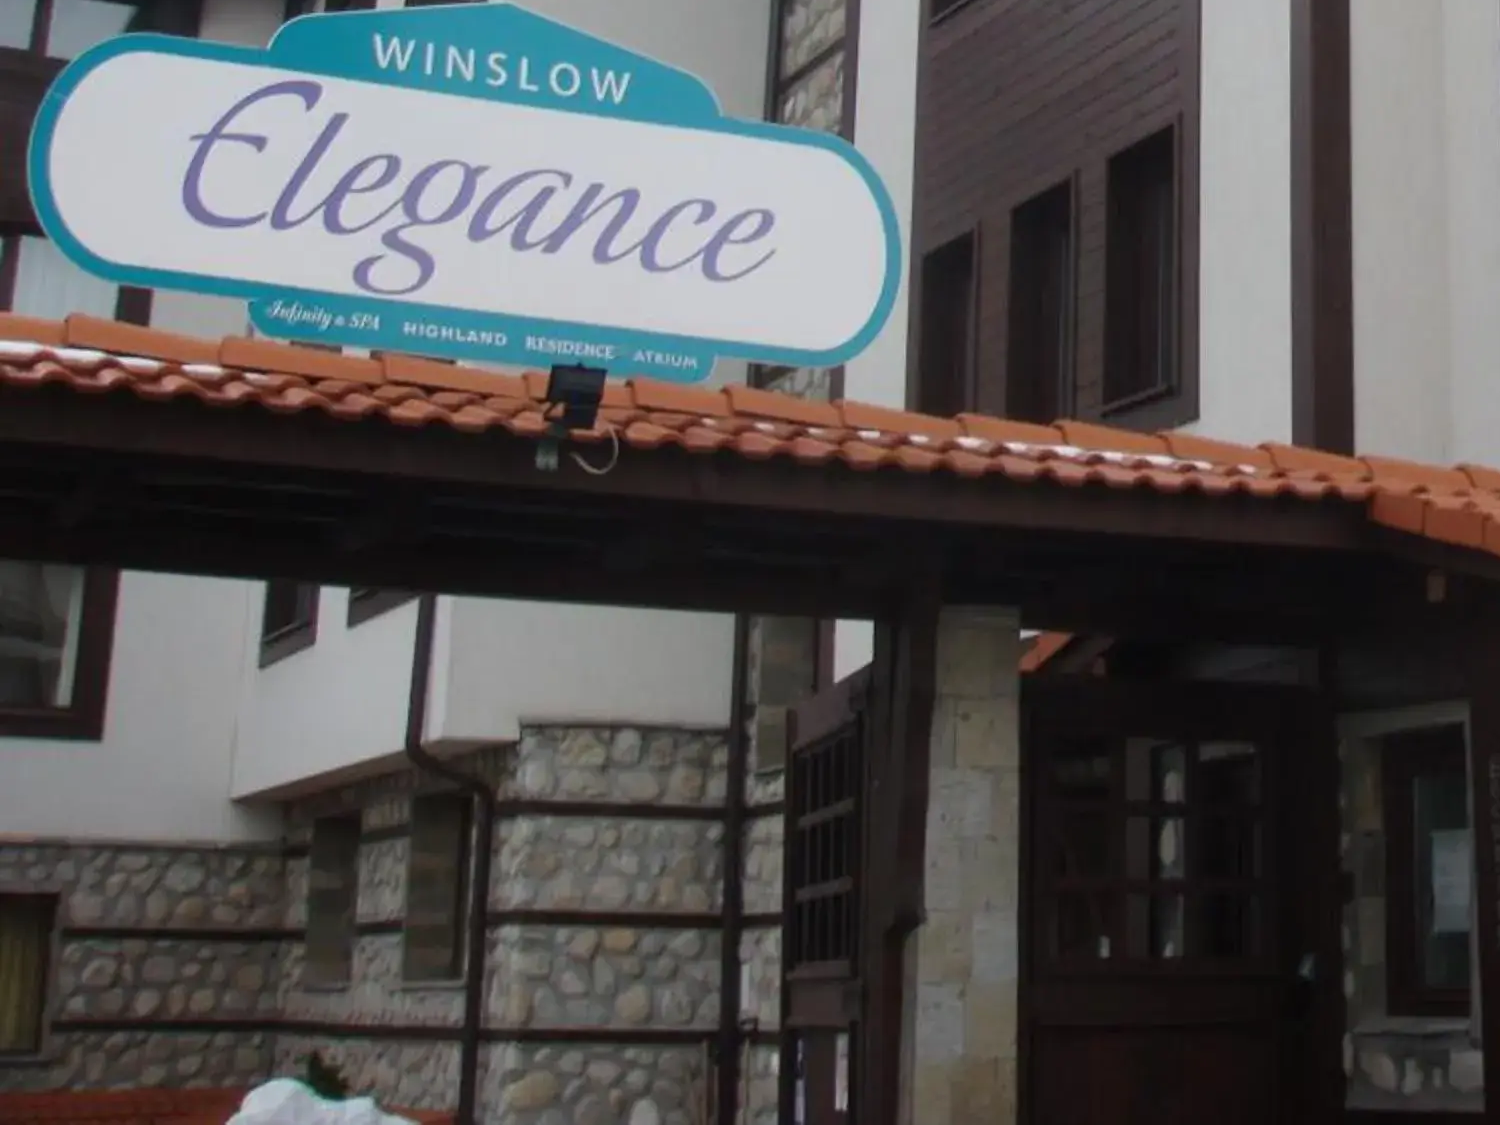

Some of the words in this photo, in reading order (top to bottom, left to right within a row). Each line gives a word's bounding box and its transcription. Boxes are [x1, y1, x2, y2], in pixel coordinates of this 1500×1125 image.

[372, 34, 634, 105] WINSLOW
[181, 80, 777, 295] Elegance
[348, 311, 380, 331] SPA
[403, 321, 508, 347] HIGHLAND
[525, 335, 615, 360] RESIDENCE
[633, 349, 698, 370] ATRIUM
